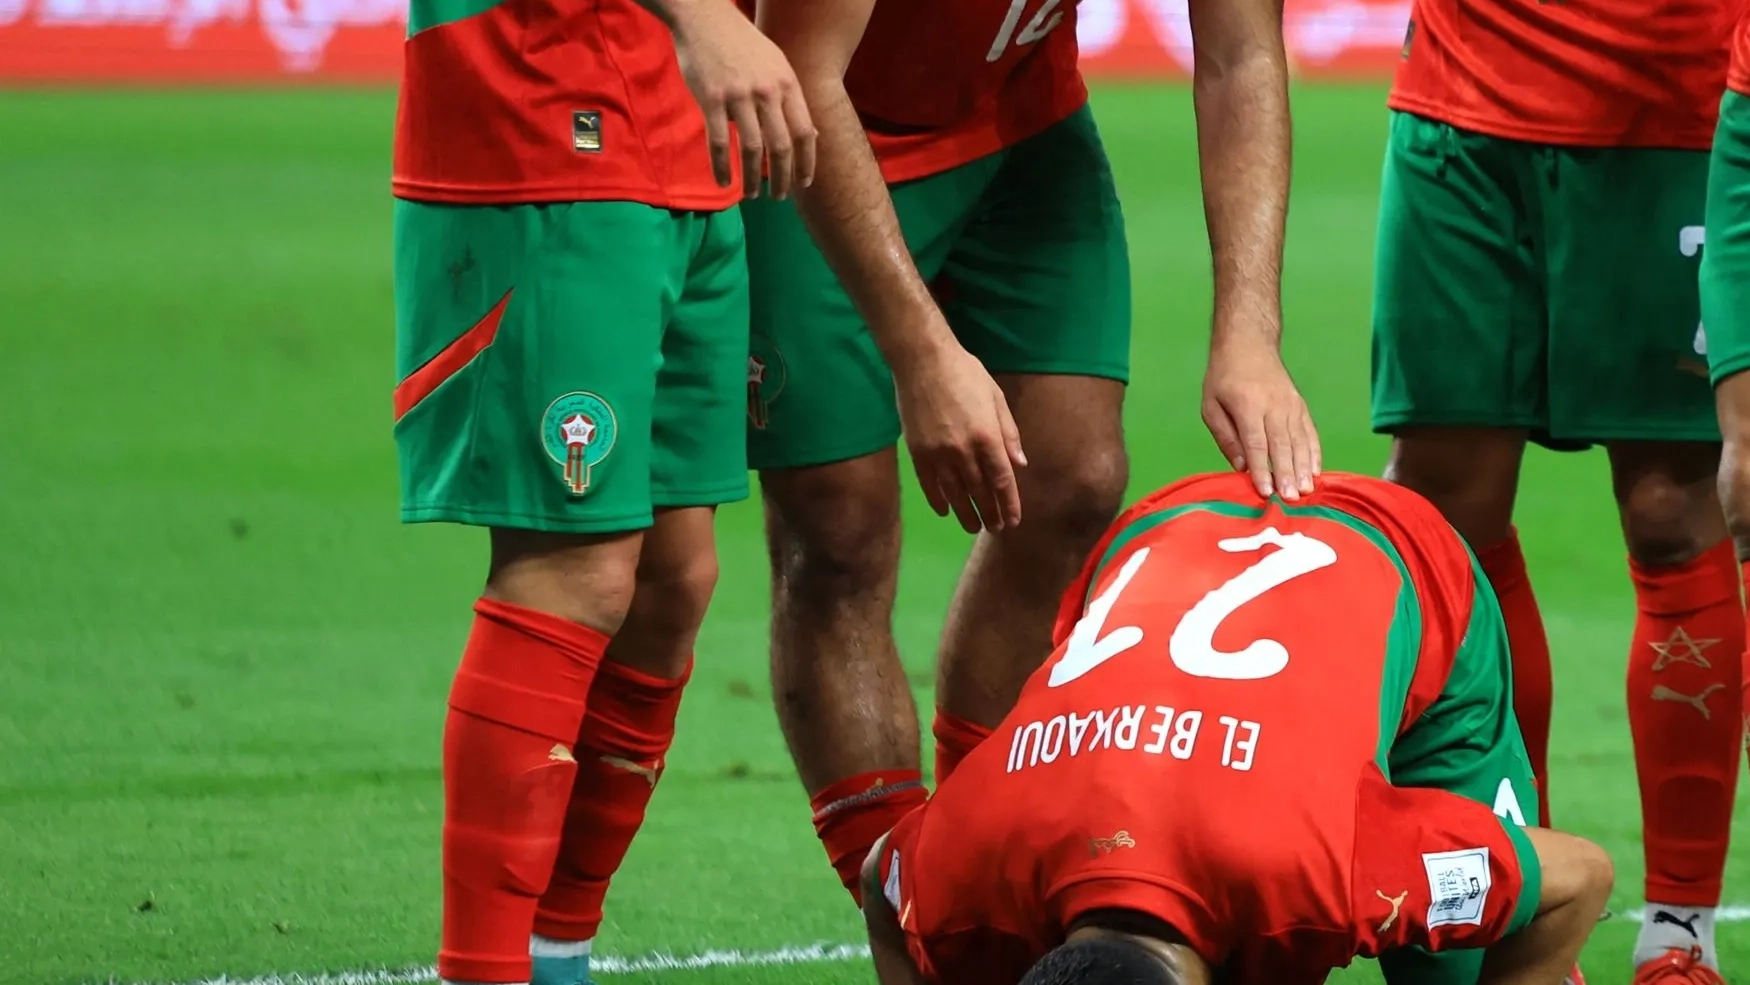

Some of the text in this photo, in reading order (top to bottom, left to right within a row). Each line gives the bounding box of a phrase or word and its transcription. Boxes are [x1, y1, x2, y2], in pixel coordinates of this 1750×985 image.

[1047, 526, 1339, 689] 21
[1006, 705, 1262, 774] EL BERKAOUI
